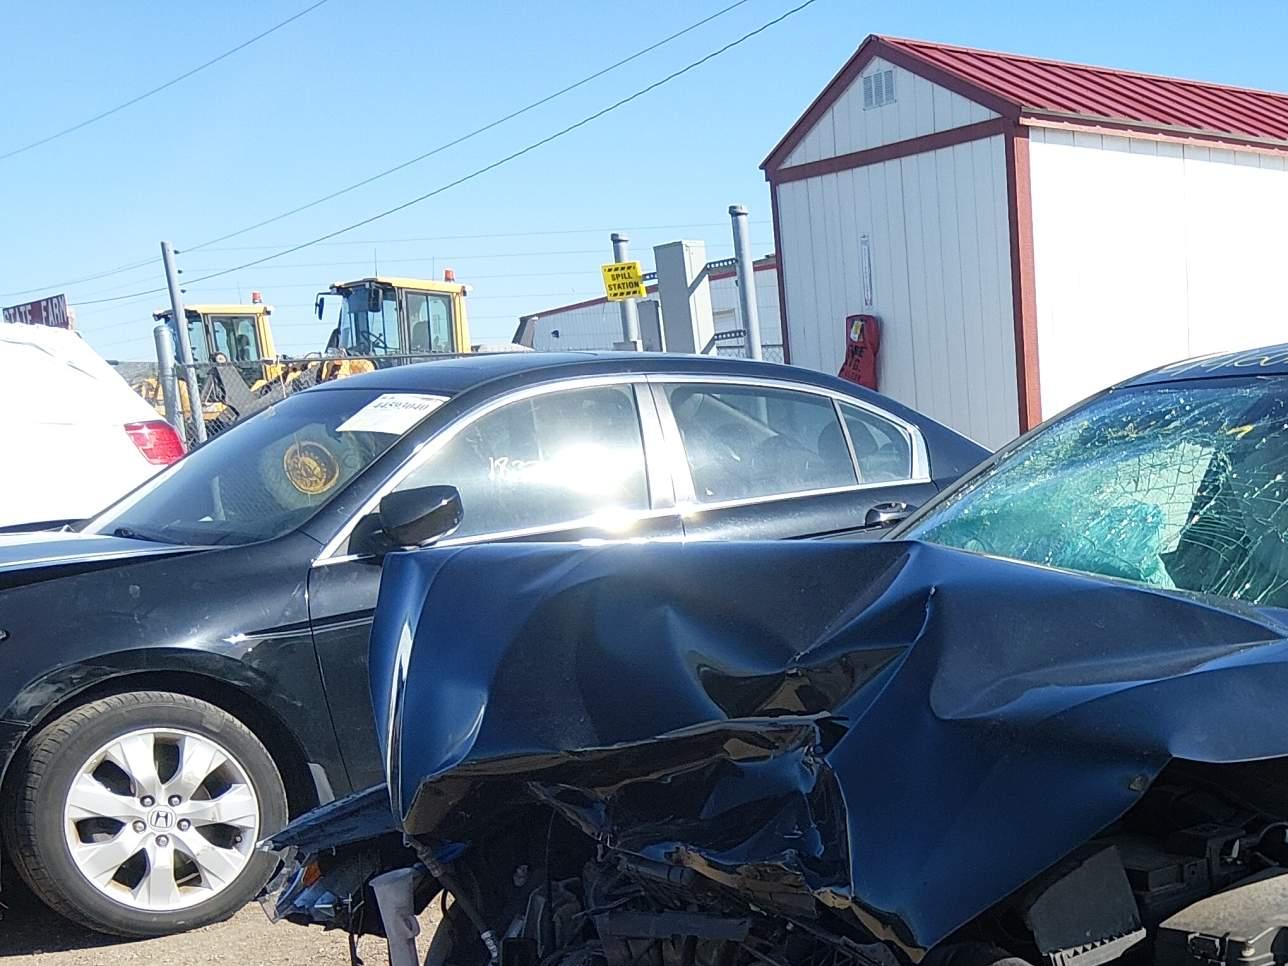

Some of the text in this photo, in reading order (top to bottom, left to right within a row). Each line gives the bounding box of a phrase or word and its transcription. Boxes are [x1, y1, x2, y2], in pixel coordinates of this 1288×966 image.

[610, 271, 633, 281] SPILL
[607, 281, 640, 291] STATION
[41, 295, 68, 325] FARM
